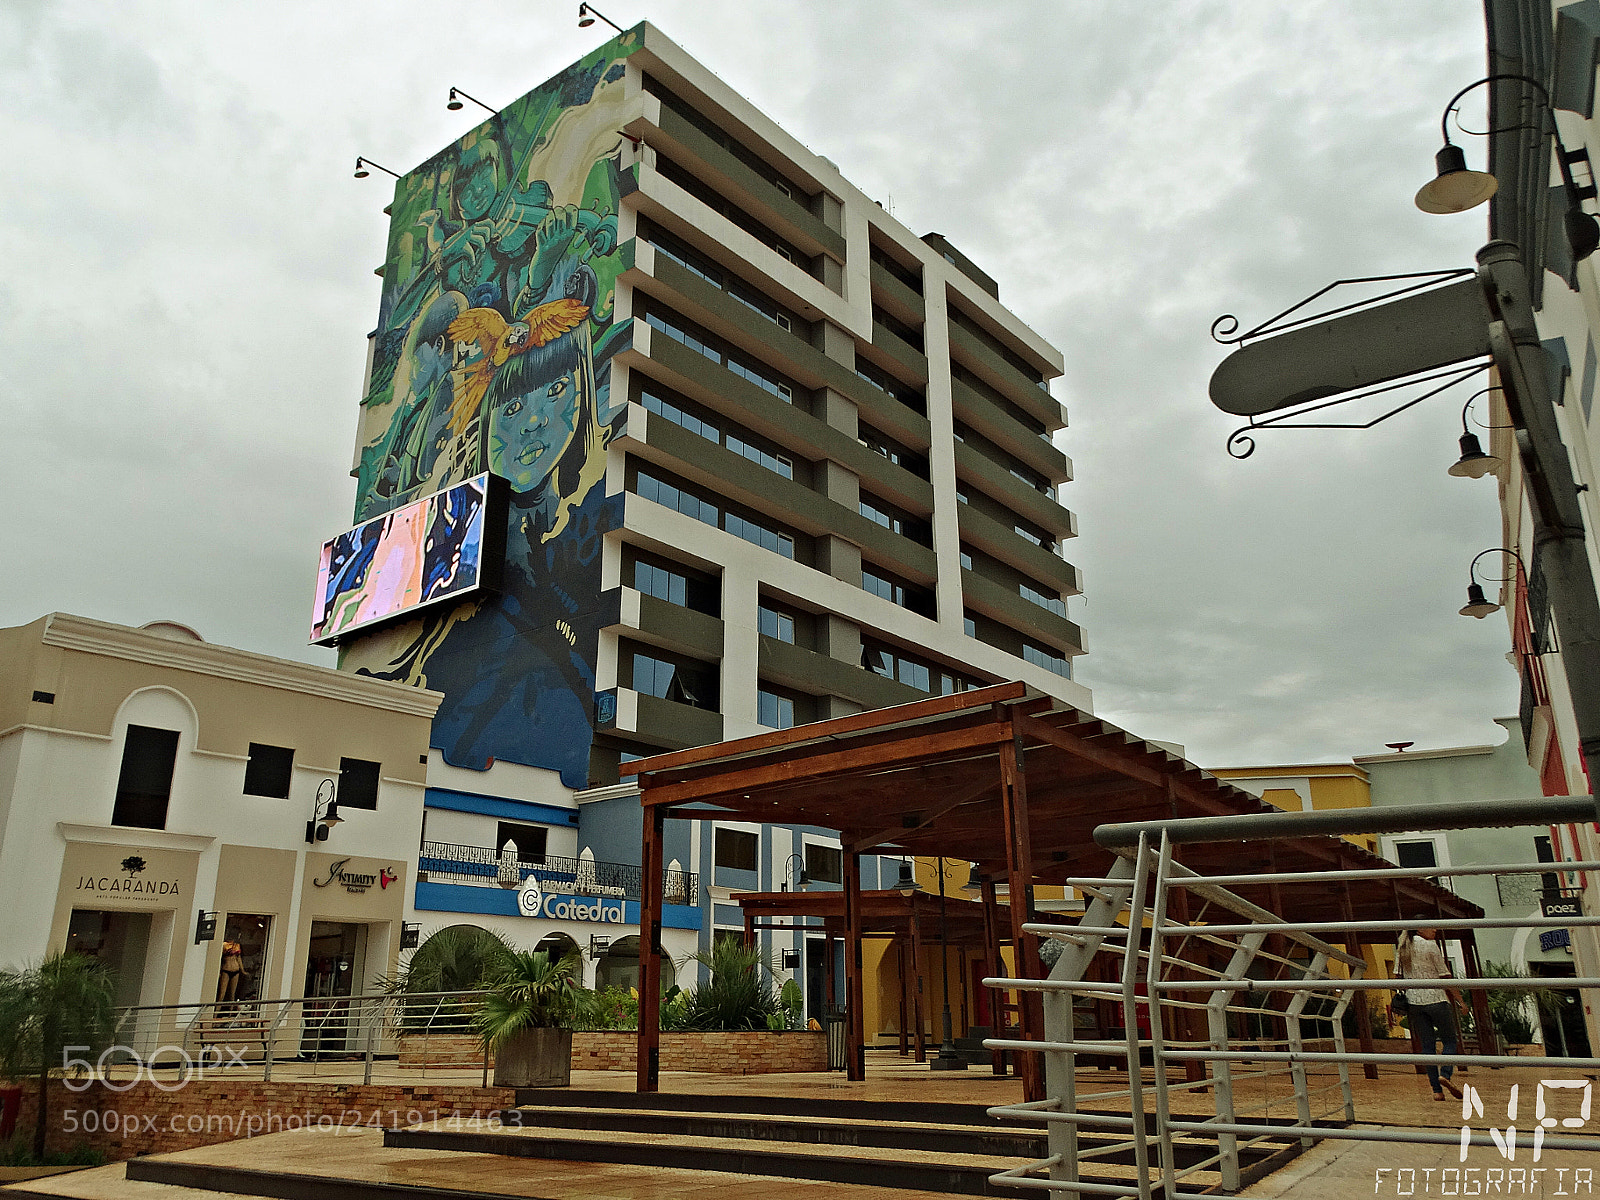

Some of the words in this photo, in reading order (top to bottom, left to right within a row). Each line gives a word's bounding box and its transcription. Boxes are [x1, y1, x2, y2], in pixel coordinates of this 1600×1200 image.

[76, 876, 180, 896] JACARANDÁ
[542, 894, 626, 924] Catedral
[1546, 904, 1577, 915] paez
